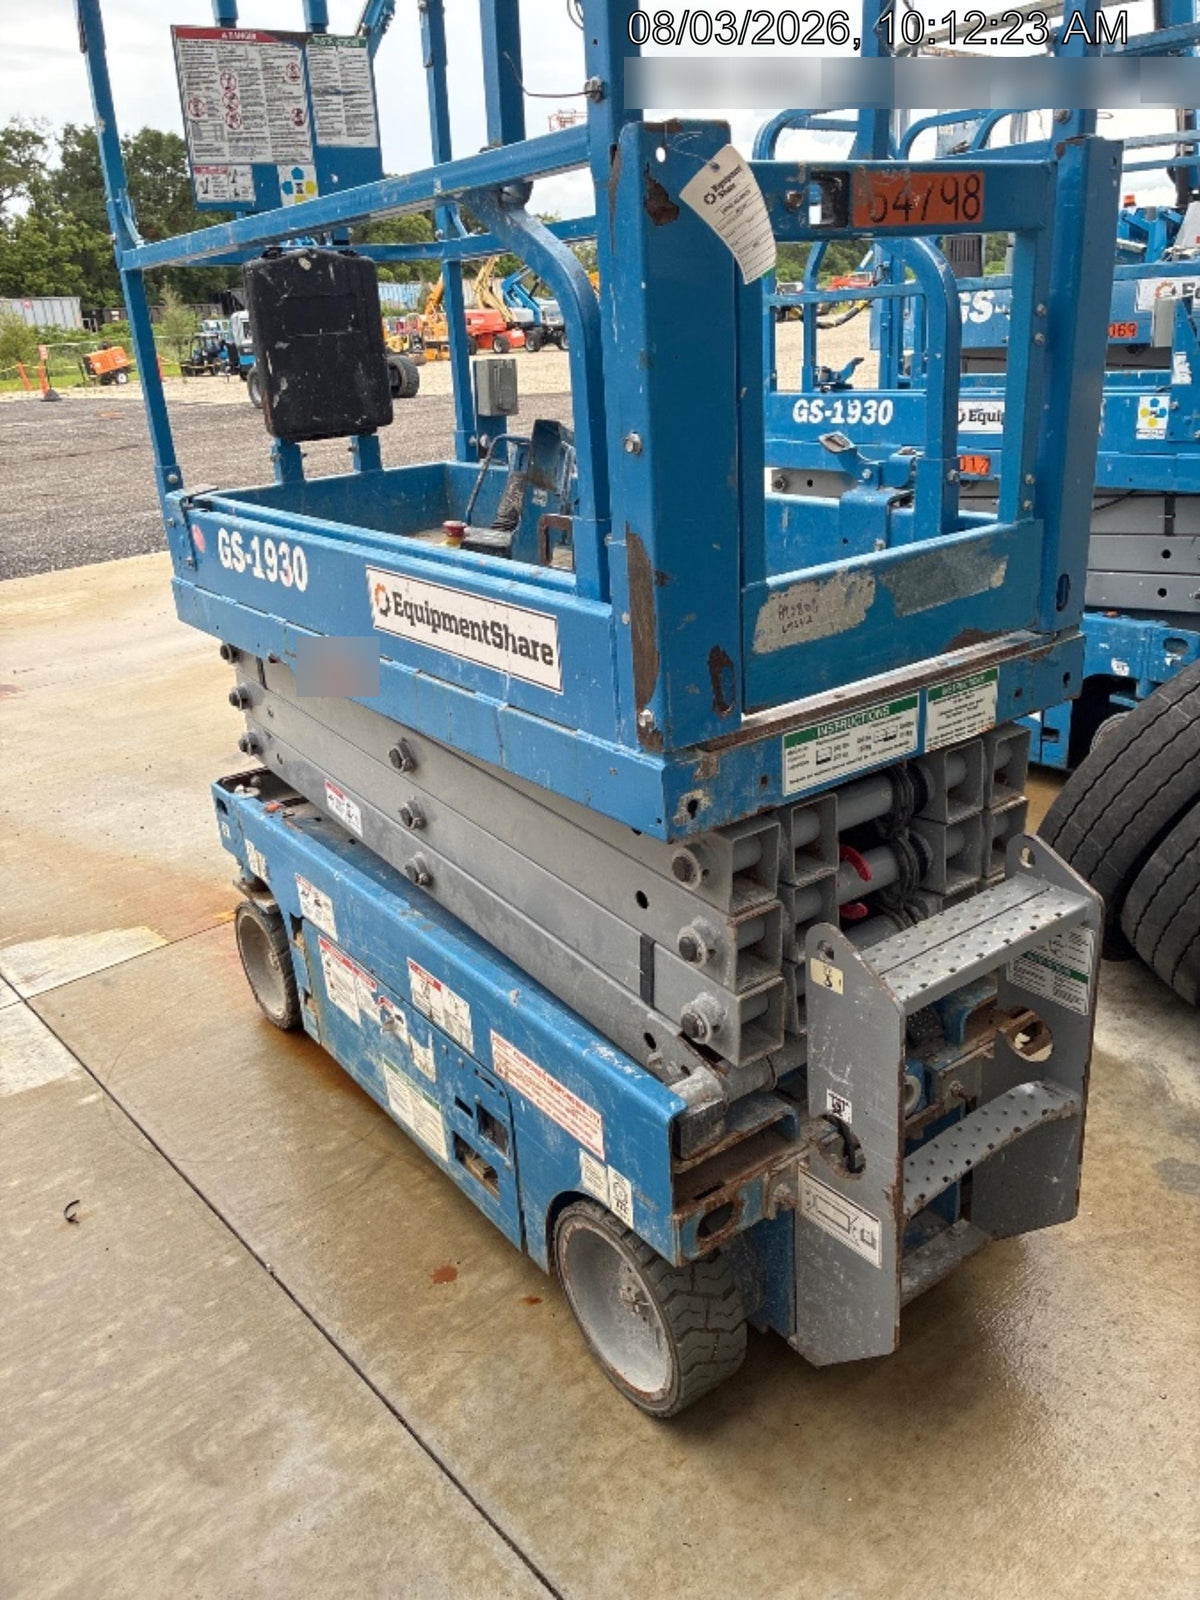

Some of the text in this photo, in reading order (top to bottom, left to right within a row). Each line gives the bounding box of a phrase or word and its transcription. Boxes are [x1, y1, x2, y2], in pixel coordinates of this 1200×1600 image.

[792, 399, 894, 426] GS-1930
[217, 528, 308, 592] GS-1930
[392, 591, 554, 666] EquipmentShare
[816, 705, 890, 739] INSTRUCTIONS
